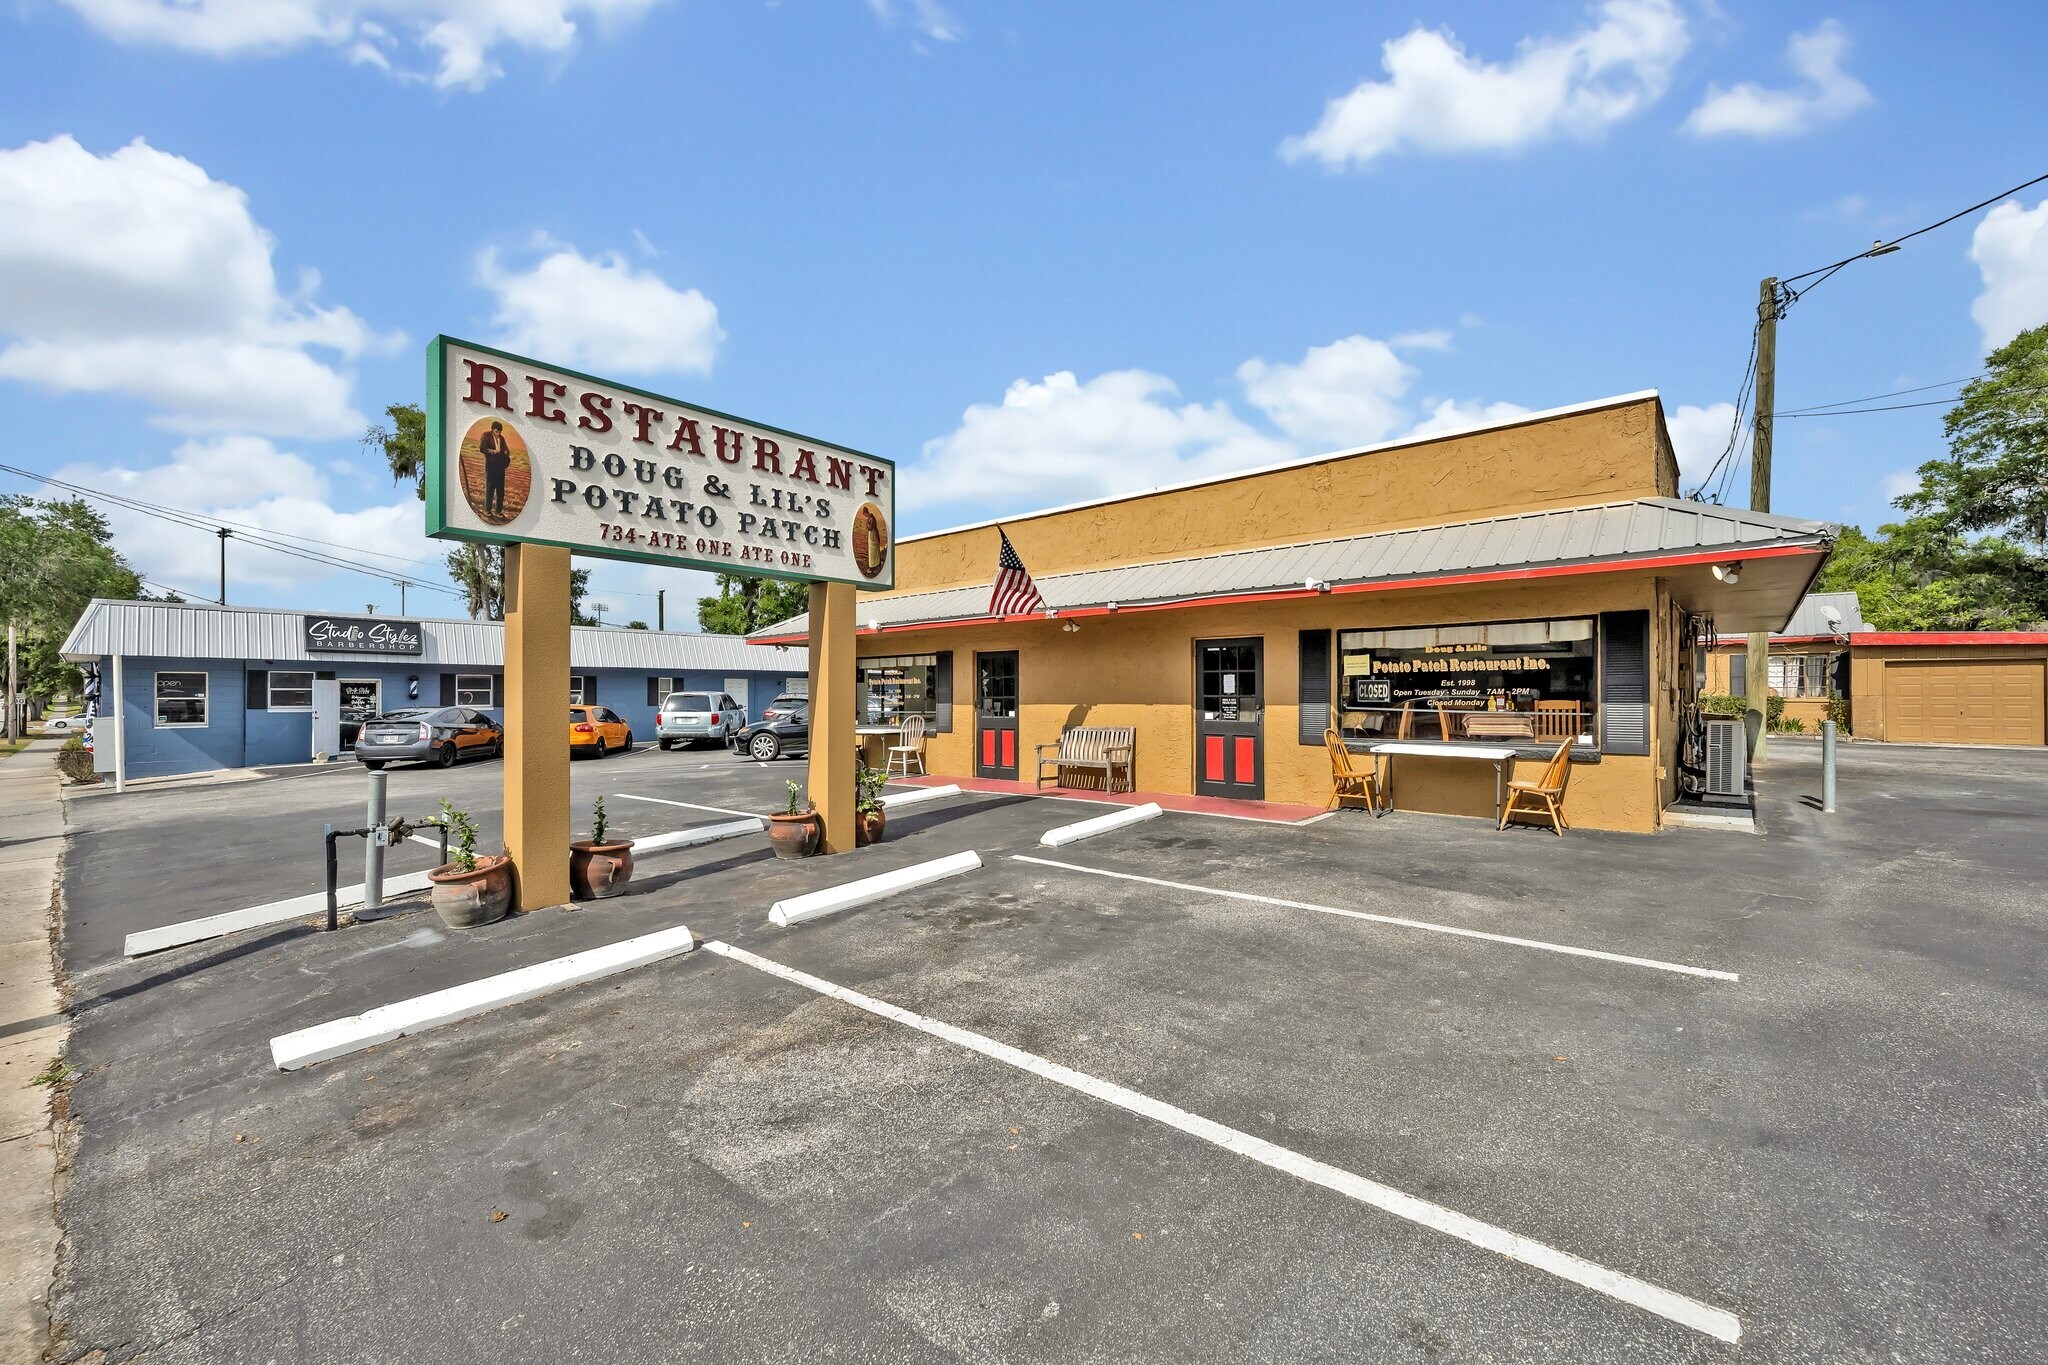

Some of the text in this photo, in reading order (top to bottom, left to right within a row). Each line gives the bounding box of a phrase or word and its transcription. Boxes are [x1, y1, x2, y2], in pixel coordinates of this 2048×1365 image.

[462, 358, 885, 498] RESTAURANT
[569, 444, 830, 518] DOUG & LIL'S
[550, 477, 841, 549] POTATO PATCH
[600, 522, 811, 568] 734-ATE ONE ATE ONE
[316, 640, 415, 650] BARBERSHOP
[1425, 646, 1454, 654] Doug
[1455, 645, 1465, 653] &
[1373, 660, 1412, 673] Potato
[1412, 659, 1448, 673] Patch
[1449, 657, 1522, 672] Restaurant
[1523, 656, 1550, 670] Inc.
[1359, 684, 1388, 698] CLOSED
[1393, 689, 1413, 698] Open
[1414, 689, 1445, 697] Tuesday
[1451, 688, 1480, 697] Sunday
[1454, 699, 1486, 708] Monday
